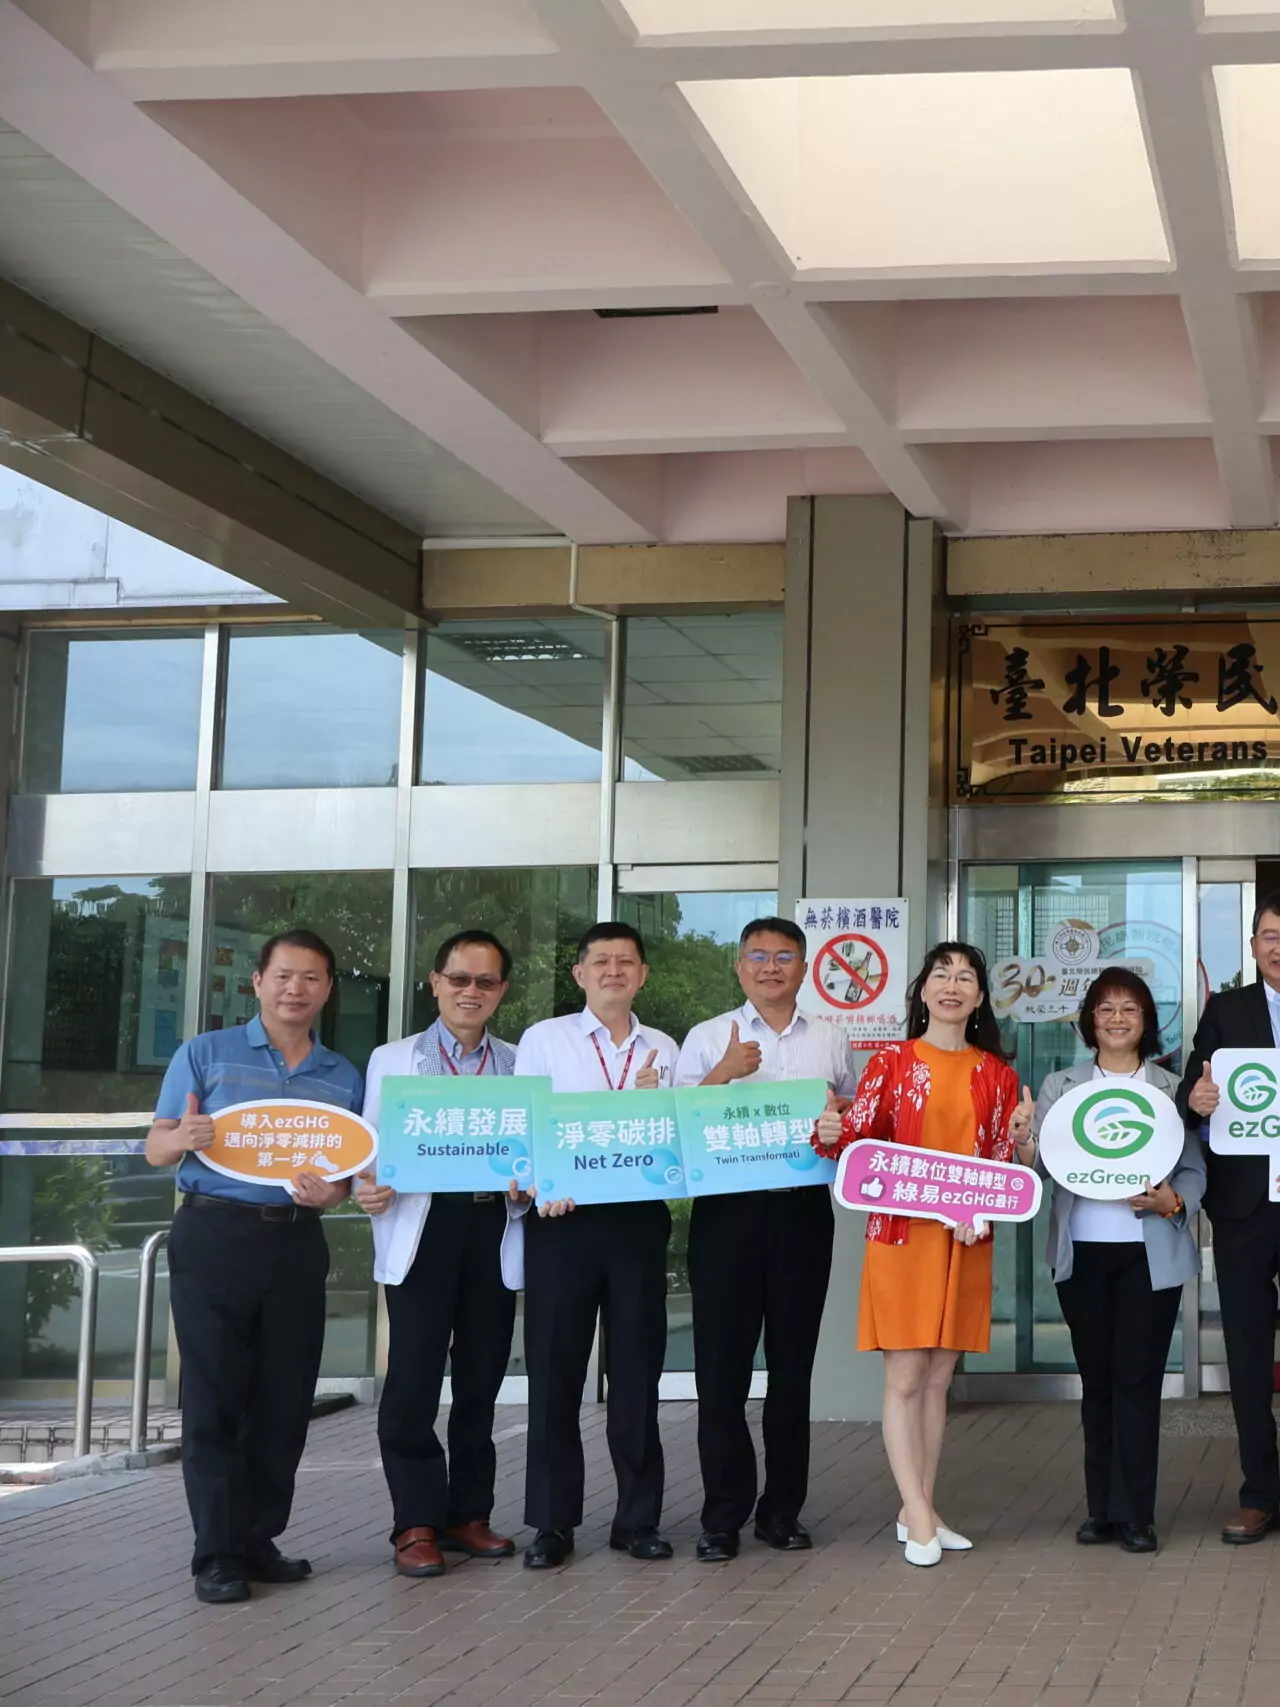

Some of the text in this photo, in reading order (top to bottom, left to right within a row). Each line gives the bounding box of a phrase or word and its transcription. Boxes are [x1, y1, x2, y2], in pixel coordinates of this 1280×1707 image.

[1009, 737, 1106, 769] Taipei
[1121, 735, 1278, 763] Veterans
[240, 1113, 329, 1129] 導入ezGHG
[723, 1106, 750, 1120] 永續
[403, 1107, 528, 1138] 永續發展
[224, 1132, 342, 1148] 邁向淨零減排的
[556, 1116, 676, 1149] 淨零碳排
[703, 1117, 816, 1153] 雙軸轉型
[417, 1142, 510, 1156] Sustainable
[257, 1151, 307, 1167] 第一步
[574, 1152, 654, 1170] Net Zero
[715, 1152, 738, 1165] Twin
[868, 1150, 1007, 1191] 永續數位雙軸轉型
[1066, 1169, 1150, 1185] ezGreen
